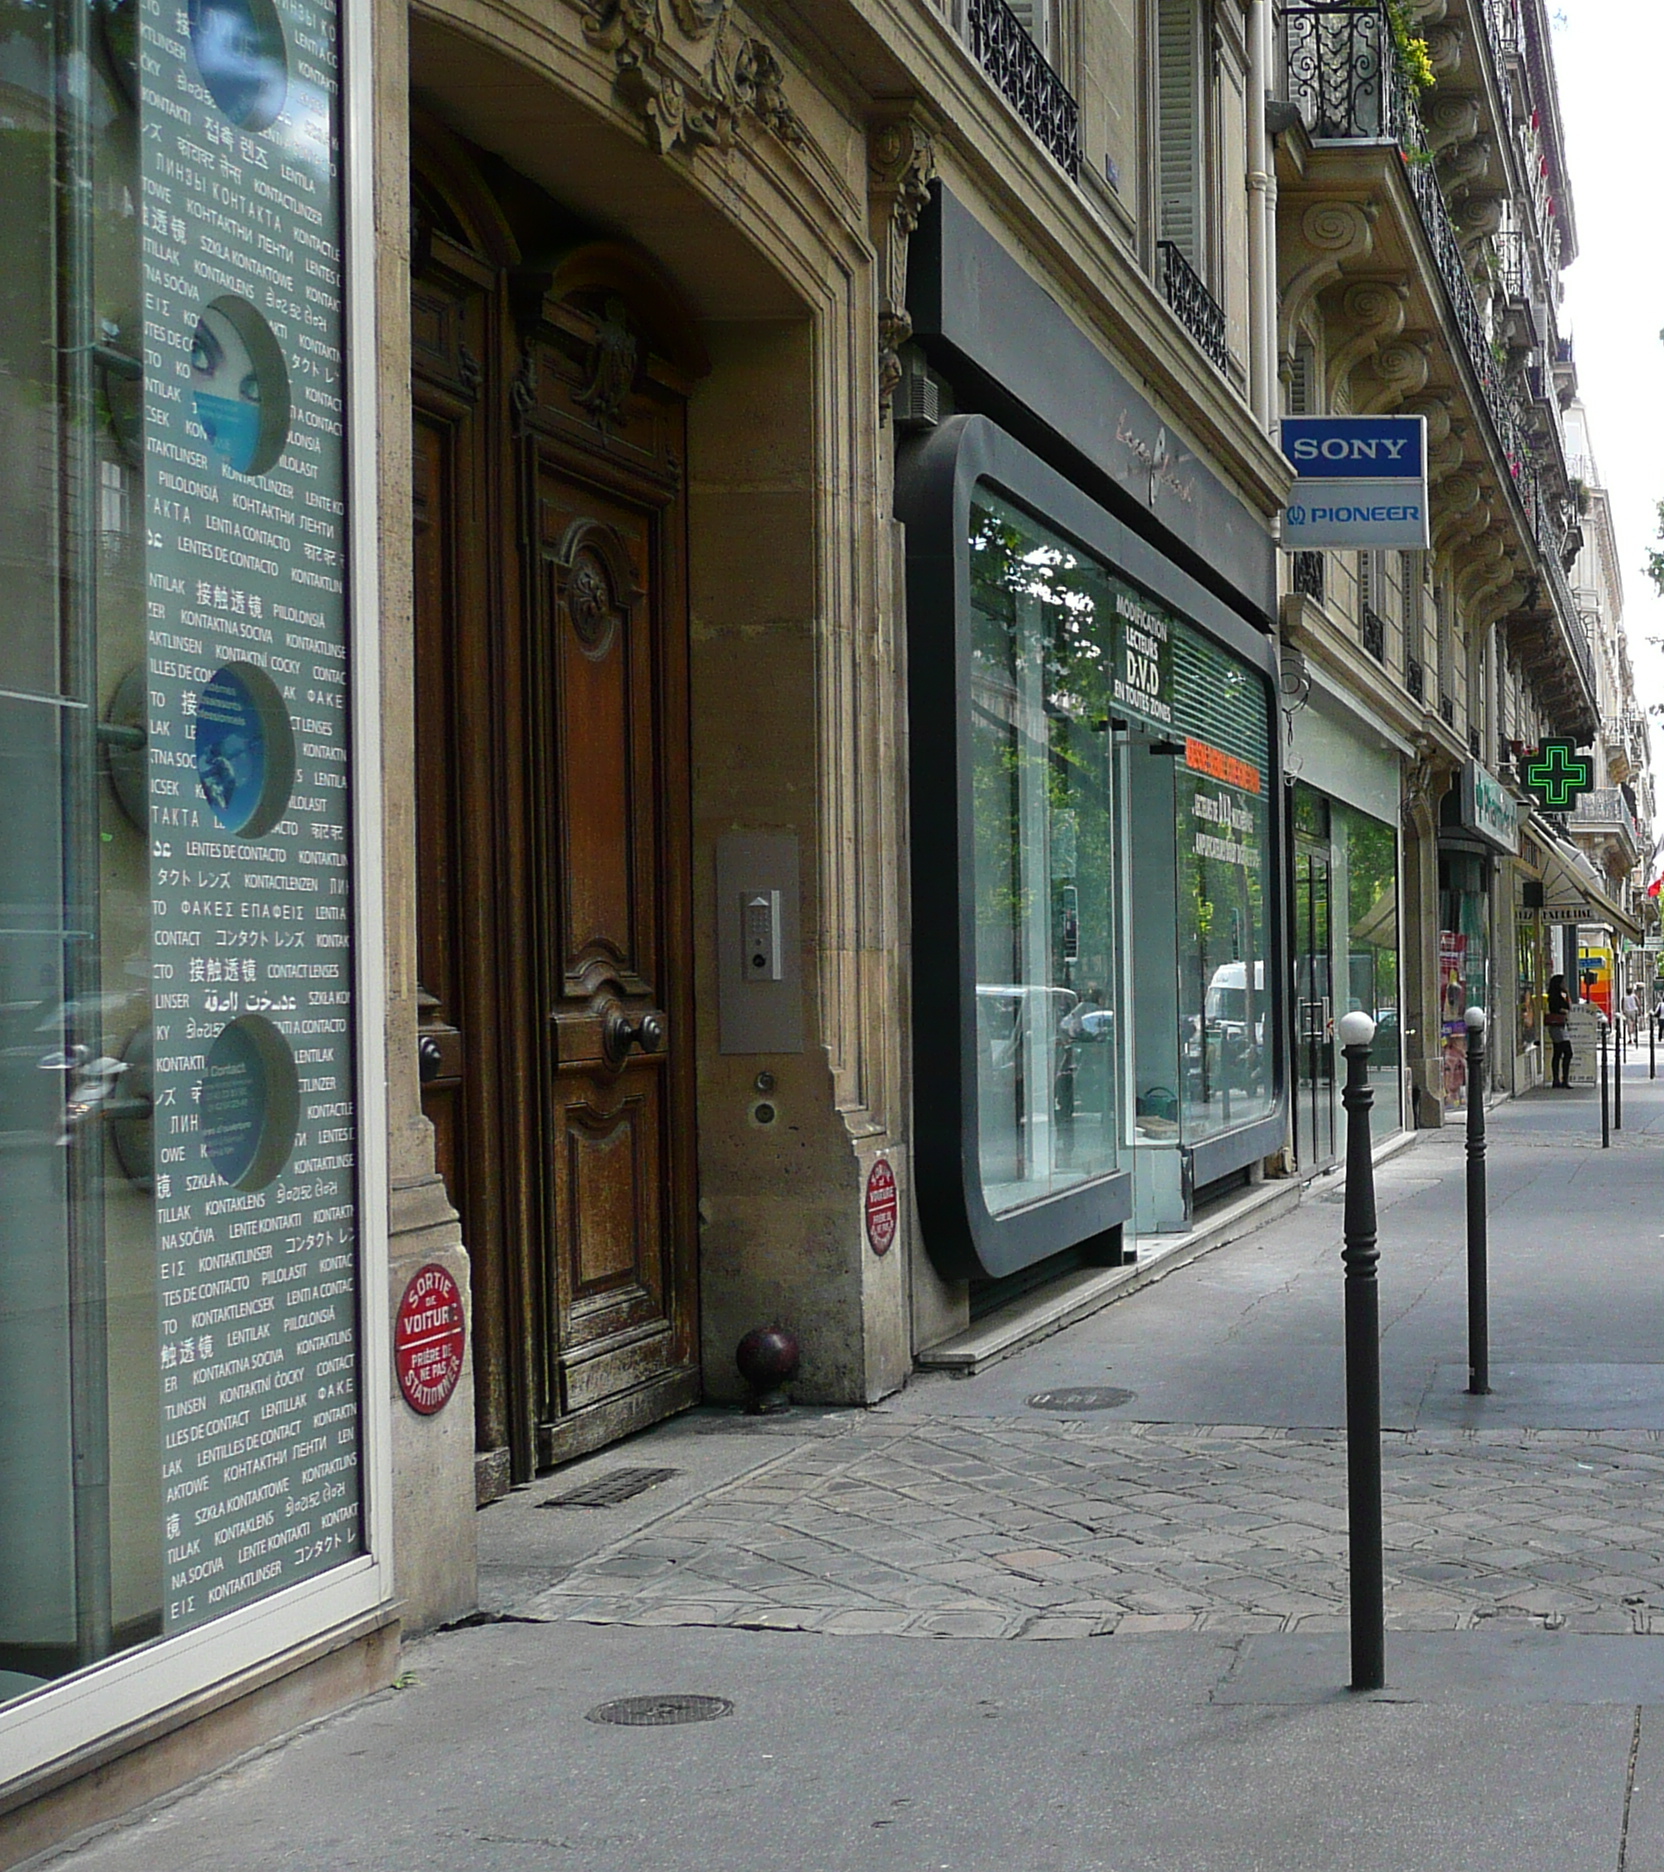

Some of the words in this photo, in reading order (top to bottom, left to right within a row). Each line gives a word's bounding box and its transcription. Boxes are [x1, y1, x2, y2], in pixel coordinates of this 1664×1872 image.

[142, 86, 191, 125] KONTAKTI
[194, 260, 254, 299] KONTAKLENS
[231, 251, 293, 292] KONTAKTOWE
[167, 330, 182, 346] DE
[1294, 438, 1407, 459] SONY
[1311, 505, 1420, 523] PIONEER
[206, 514, 232, 535] LENTI
[242, 525, 291, 552] CONTACTO
[177, 536, 214, 558] LENTES
[215, 547, 229, 563] DE
[230, 550, 279, 576] CONTACTO
[181, 609, 239, 637] KONTAKTNA
[1116, 594, 1167, 642] MODIFICATION
[1126, 625, 1158, 661] LECTEURS
[178, 664, 192, 680] DE
[1114, 679, 1125, 700] EN
[1125, 684, 1149, 712] TOUTES
[1150, 697, 1171, 723] ZONES
[186, 841, 220, 858] LENTES
[223, 844, 237, 859] DE
[239, 845, 287, 863] CONTACTO
[244, 874, 319, 892] KONTACTLENZEN
[155, 930, 202, 946] CONTACT
[215, 930, 268, 947] コンタクト
[274, 931, 305, 948] レンズ
[189, 956, 257, 983] 接触透镜
[268, 964, 308, 979] CONTACT
[308, 964, 339, 978] LENSES
[155, 993, 190, 1009] LINSER
[302, 1019, 347, 1034] CONTACTO
[156, 1055, 205, 1073] KONTAKTI
[161, 1146, 186, 1163] OWE
[205, 1193, 266, 1216] KONTAKLENS
[229, 1220, 258, 1240] LENTE
[259, 1212, 302, 1234] KONTAKTI
[162, 1234, 177, 1251] NA
[285, 1231, 334, 1254] コンタクト
[199, 1244, 273, 1274] KONTAKTLINSER
[162, 1288, 181, 1307] TES
[183, 1283, 197, 1300] DE
[199, 1275, 250, 1299] CONTACTO
[286, 1287, 312, 1306] LENTI
[409, 1272, 452, 1309] SORTIE
[425, 1295, 437, 1306] DE
[192, 1296, 275, 1329] KONTAKTLENCSEK
[404, 1303, 458, 1335] VOITUR
[227, 1323, 271, 1348] LENTILAK
[192, 1359, 250, 1386] KONTAKTNA
[316, 1353, 355, 1377] CONTACT
[420, 1366, 431, 1382] NE
[432, 1360, 447, 1379] PAS
[405, 1355, 460, 1405] STATIONNER
[165, 1396, 207, 1421] TLINSEN
[261, 1393, 308, 1420] LENTILLAK
[191, 1423, 205, 1441] DE
[206, 1409, 250, 1437] CONTACT
[197, 1440, 245, 1467] LENTILLES
[246, 1436, 260, 1451] DE
[260, 1420, 303, 1446] CONTACT
[162, 1458, 183, 1479] LAK
[167, 1475, 210, 1503] AKTOWE
[226, 1477, 290, 1513] KONTAKTOWE
[214, 1510, 275, 1546] KONTAKLENS
[238, 1543, 267, 1564] LENTE
[267, 1521, 311, 1549] KONTAKTI
[171, 1575, 187, 1590] NA
[208, 1560, 282, 1604] KONTAKTLINSER
